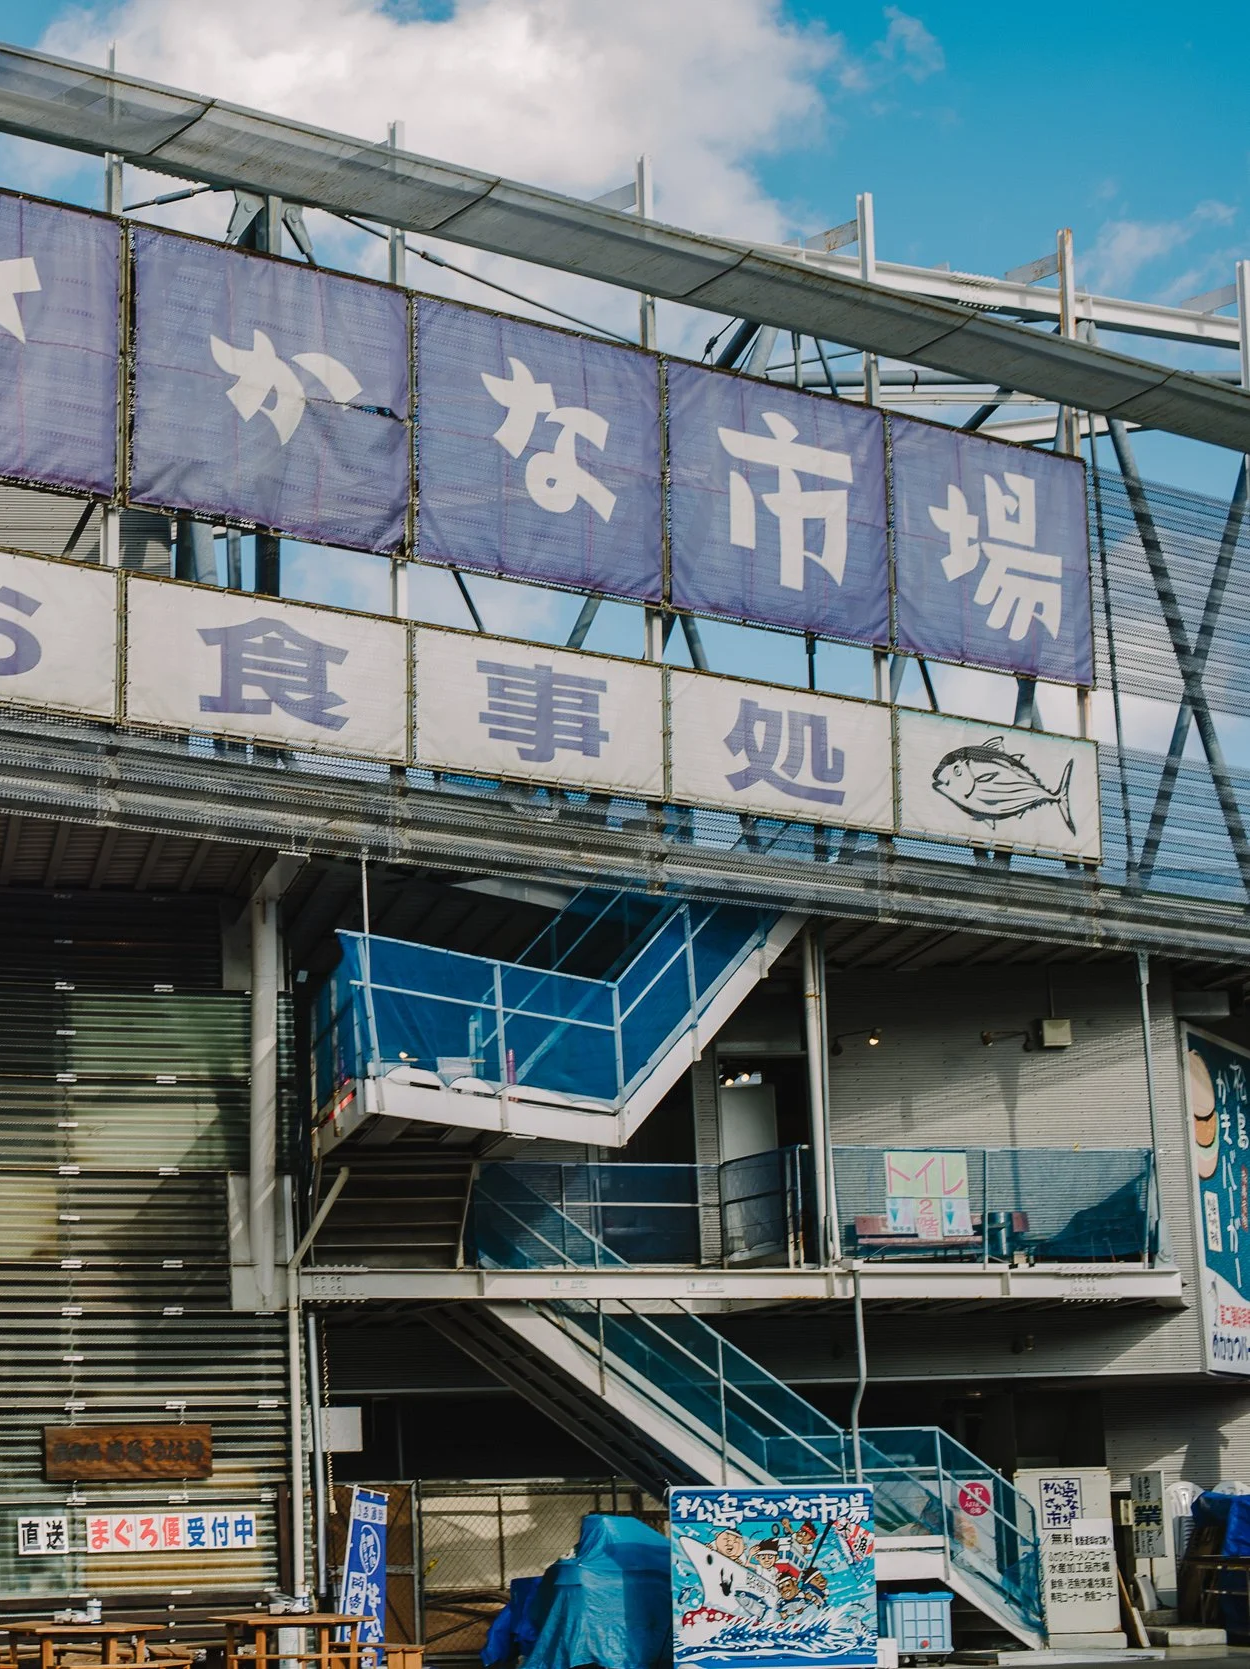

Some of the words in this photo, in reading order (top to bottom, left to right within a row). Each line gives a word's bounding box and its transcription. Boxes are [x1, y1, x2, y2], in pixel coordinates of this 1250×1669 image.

[887, 1155, 964, 1195] トイレ
[917, 1199, 939, 1237] 2階
[1043, 1480, 1078, 1500] 松島
[1044, 1498, 1080, 1511] さかな
[676, 1492, 871, 1529] 松島さかな市場
[21, 1520, 65, 1551] 直送
[90, 1514, 254, 1550] まぐろ便受付中
